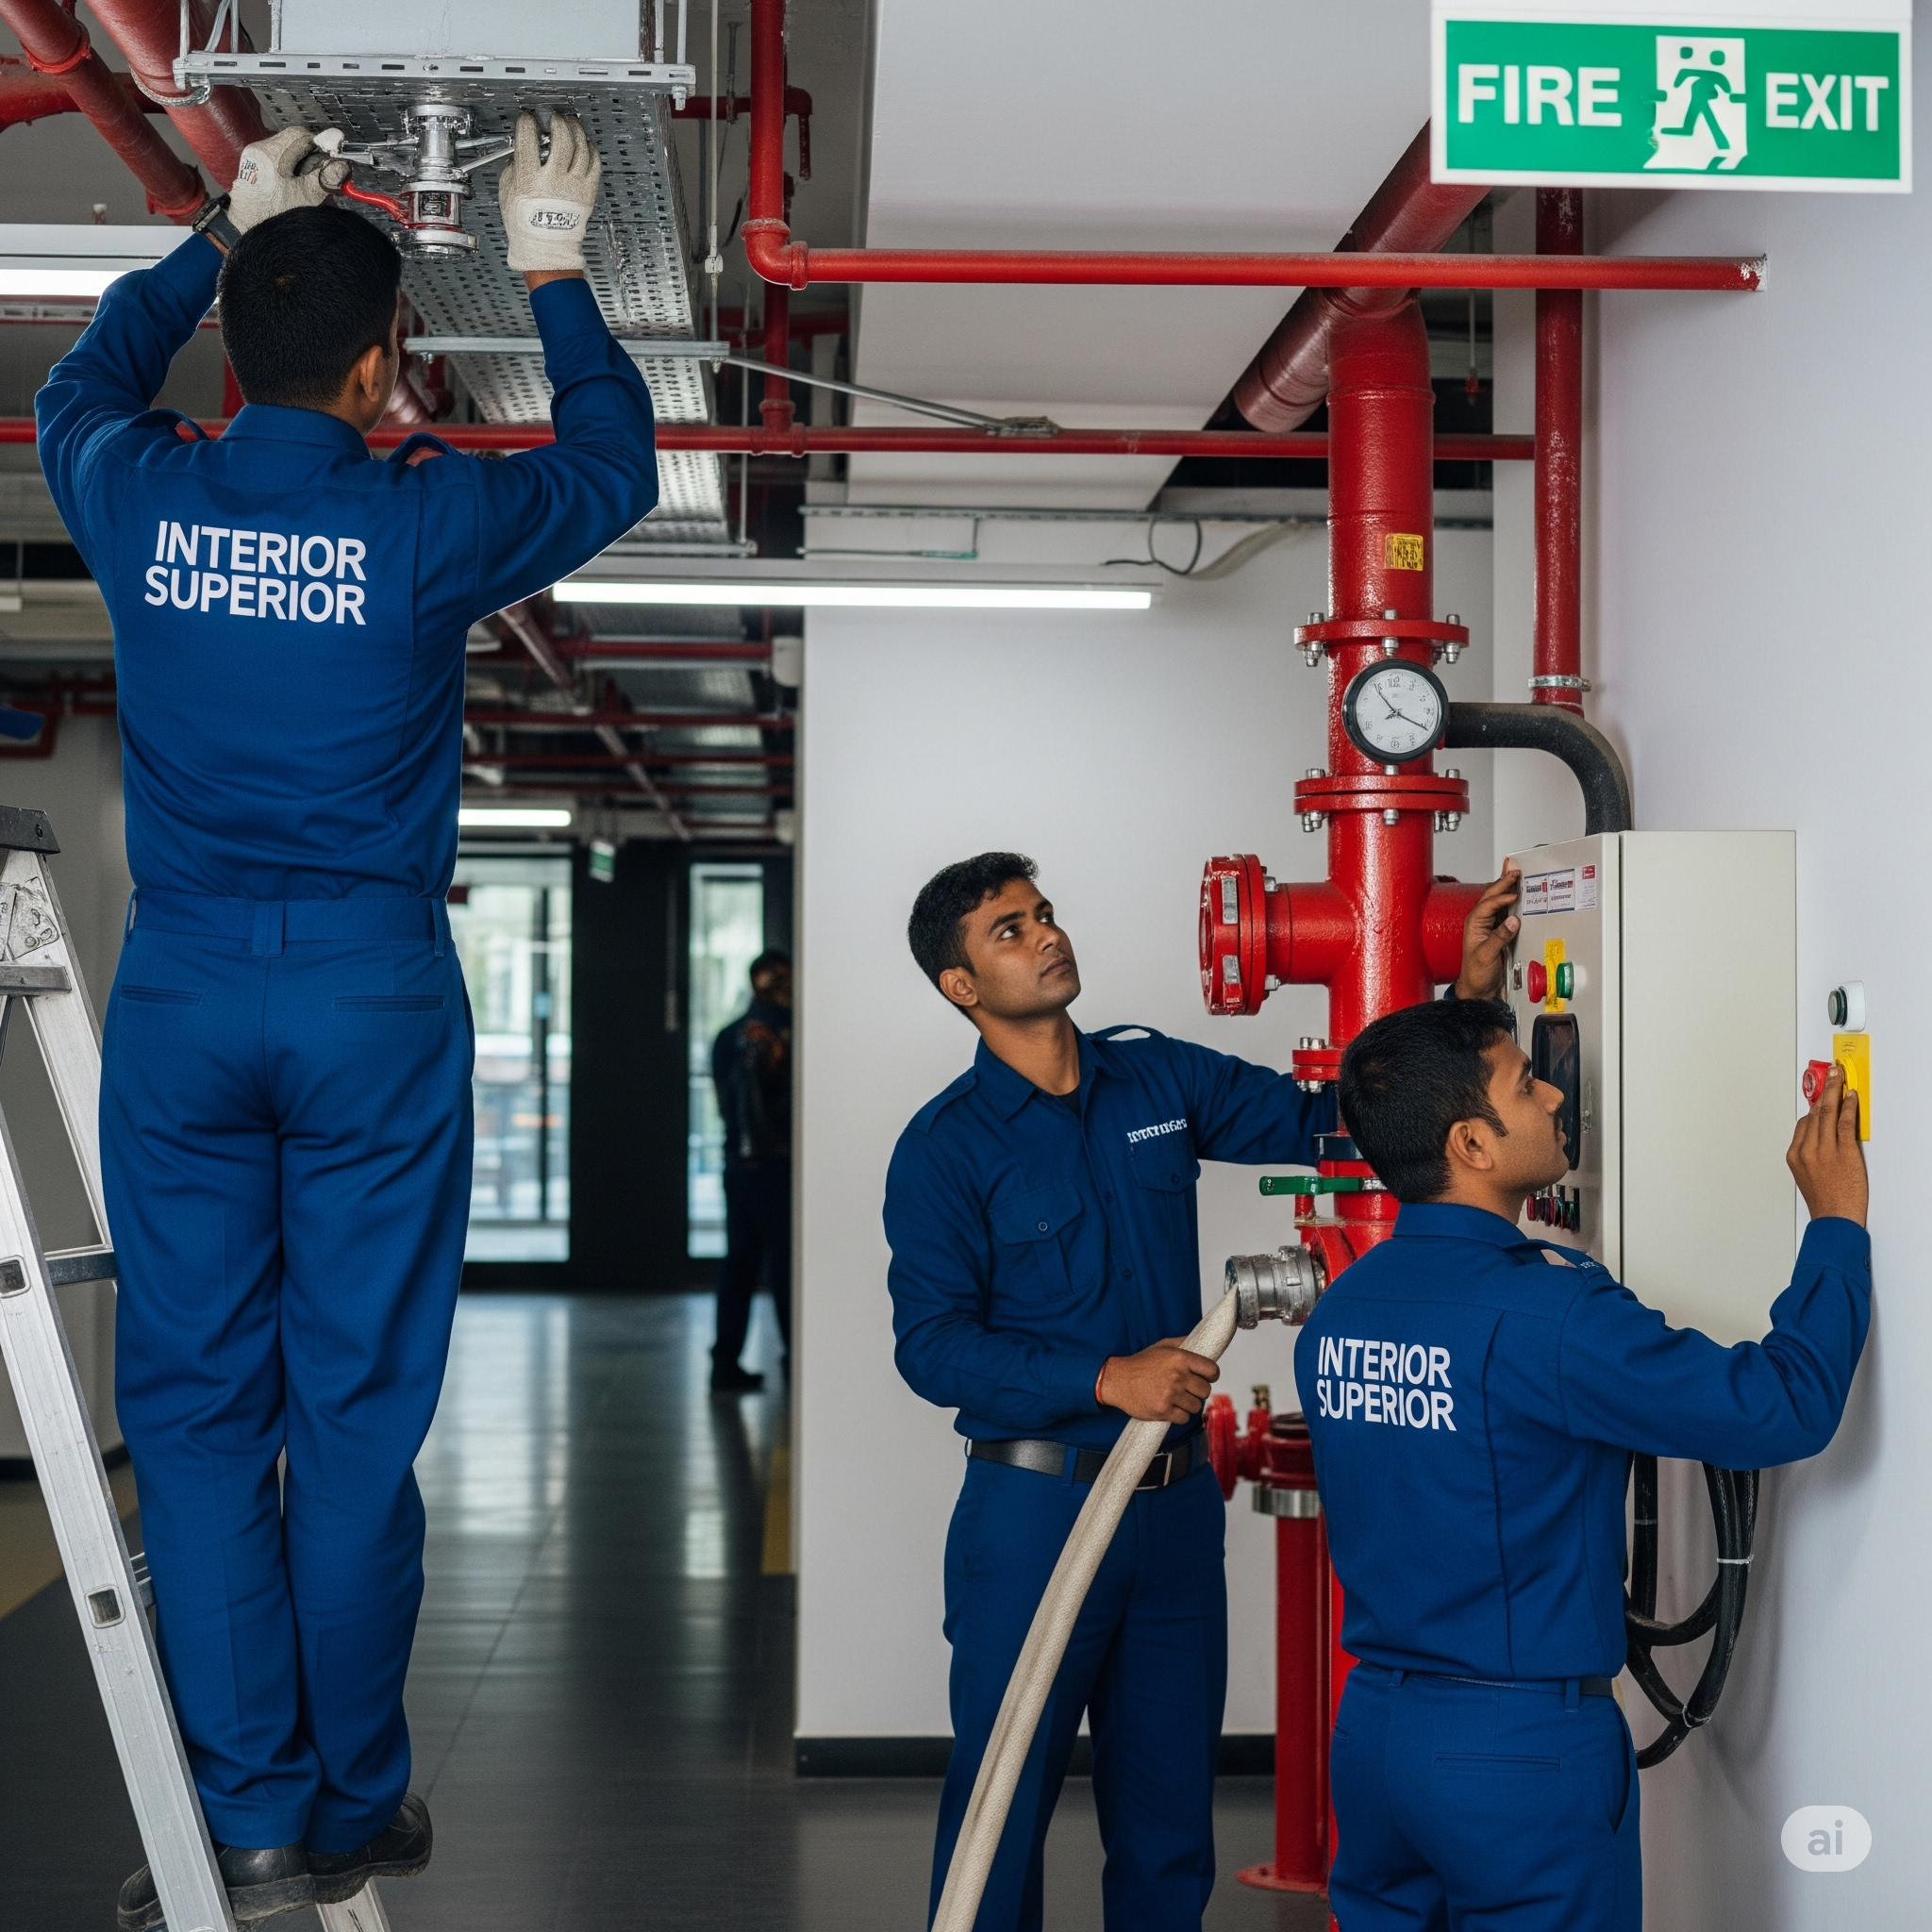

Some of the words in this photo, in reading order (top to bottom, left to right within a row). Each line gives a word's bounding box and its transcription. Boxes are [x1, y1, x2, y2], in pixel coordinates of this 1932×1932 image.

[1457, 63, 1623, 126] FIRE
[1765, 72, 1890, 131] EXIT
[155, 520, 367, 581] INTERIOR
[144, 565, 367, 625] SUPERIOR
[1318, 1336, 1453, 1389] INTERIOR
[1316, 1378, 1457, 1432] SUPERIOR
